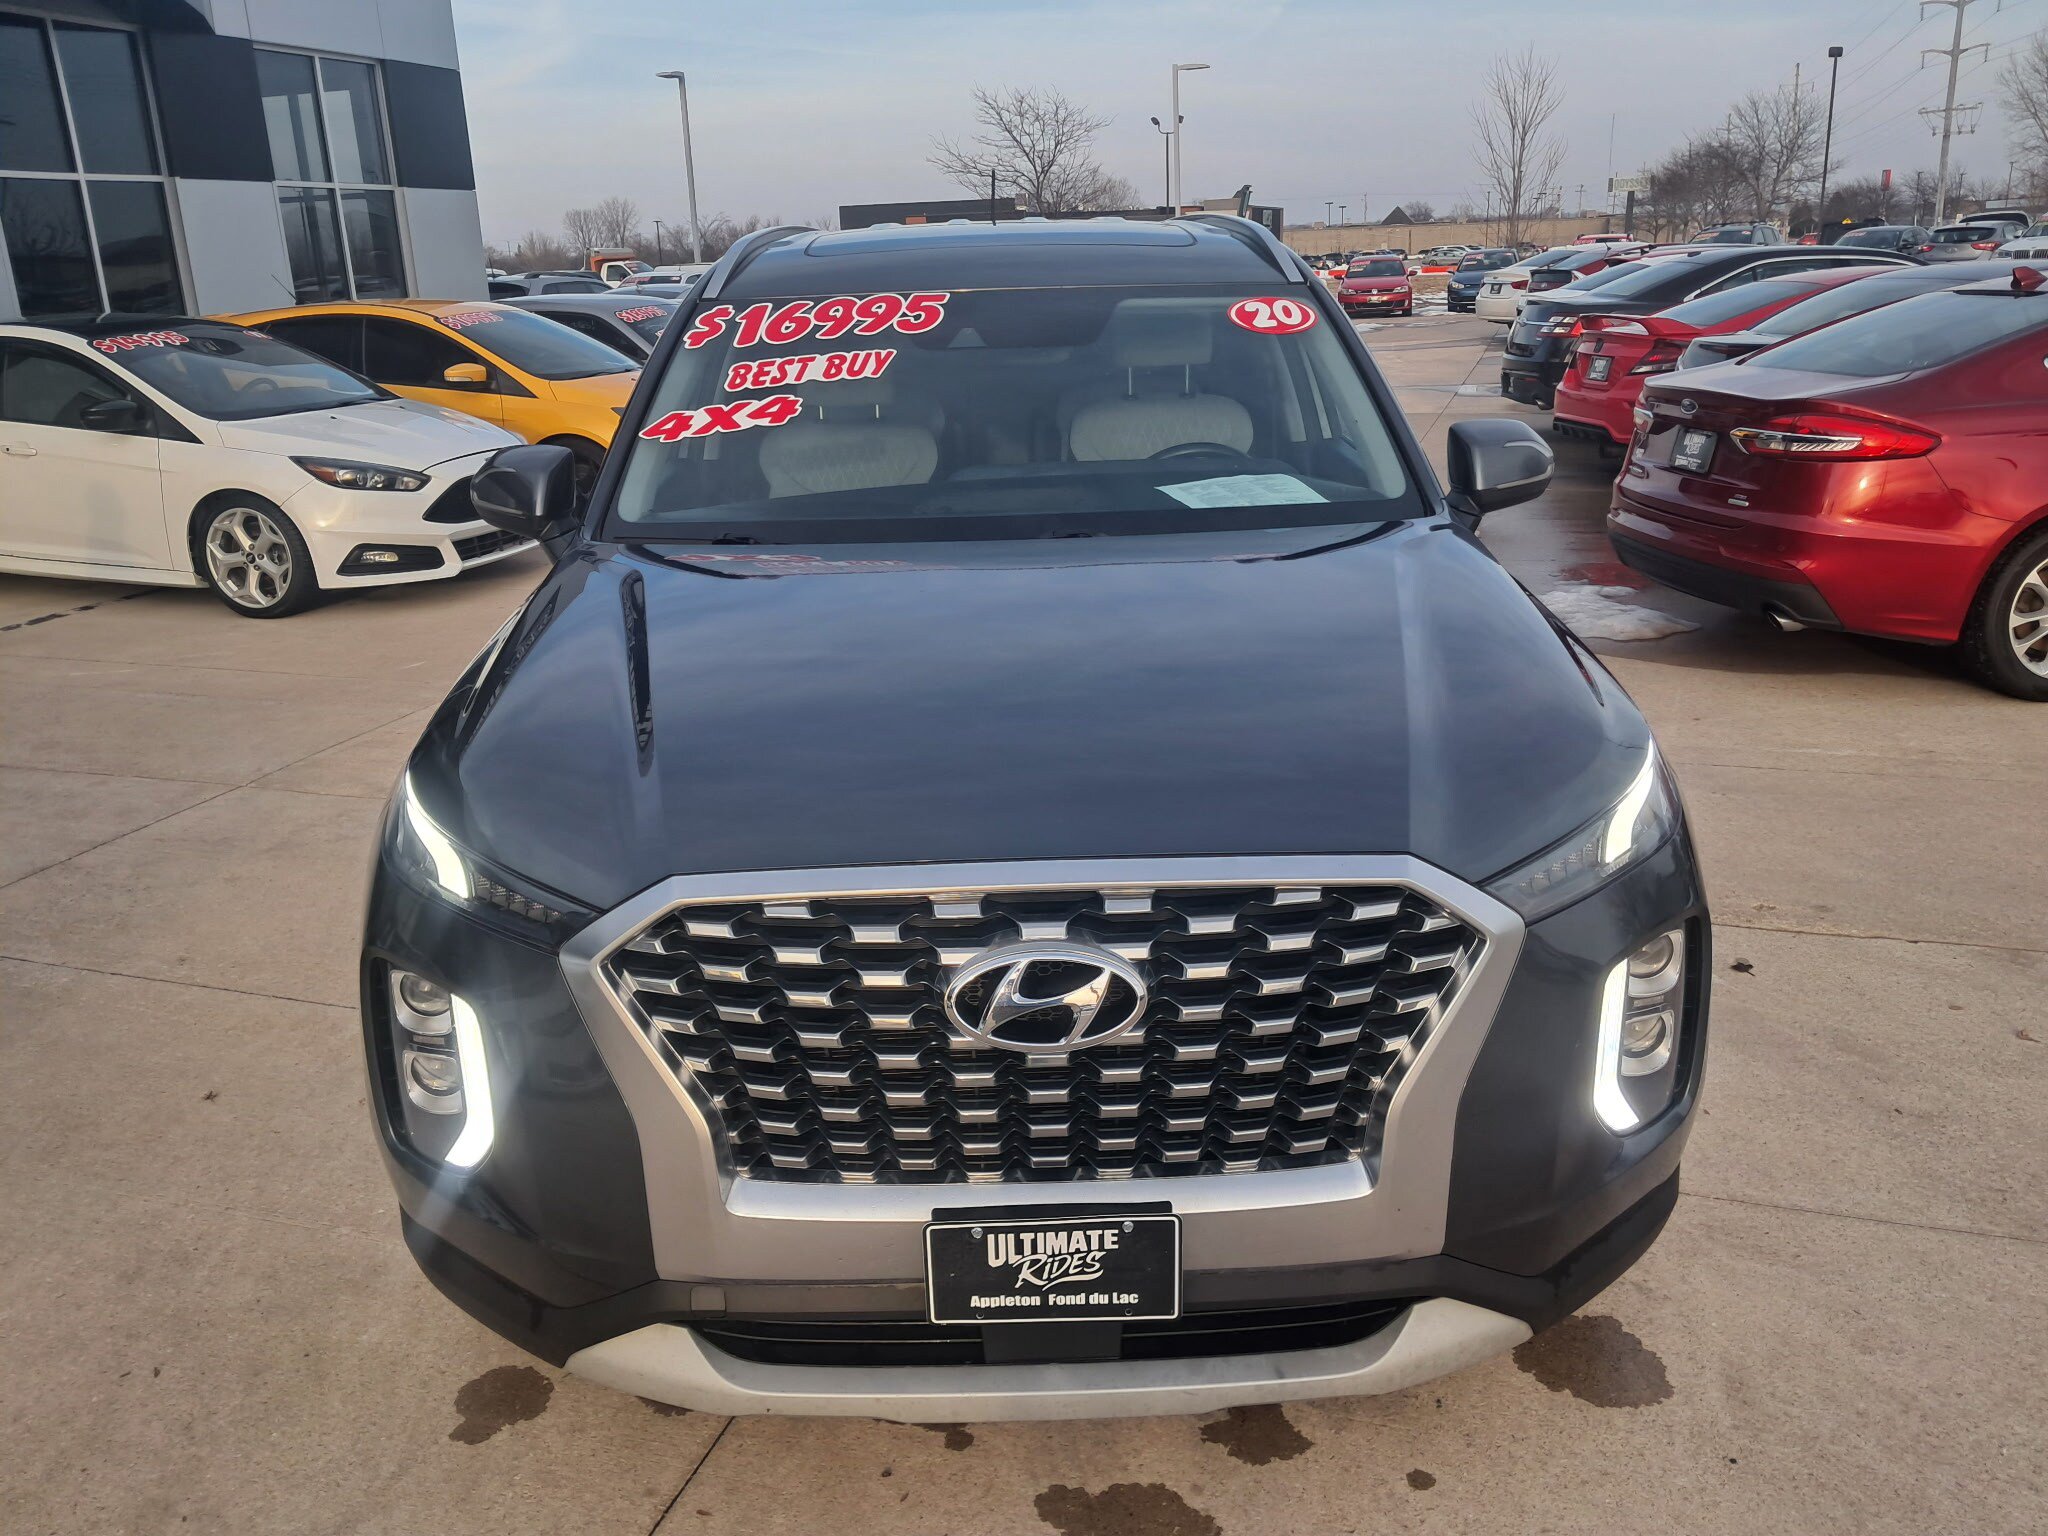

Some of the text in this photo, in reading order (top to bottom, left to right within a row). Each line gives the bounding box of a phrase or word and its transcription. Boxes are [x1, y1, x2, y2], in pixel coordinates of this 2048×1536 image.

[684, 293, 949, 348] $16995
[1244, 299, 1302, 328] 20
[93, 331, 189, 353] $14995
[726, 350, 896, 390] BEST BUY
[641, 395, 803, 442] 4X4
[987, 1229, 1119, 1268] ULTIMATE
[970, 1292, 1139, 1308] Appleton Fond du Lac
